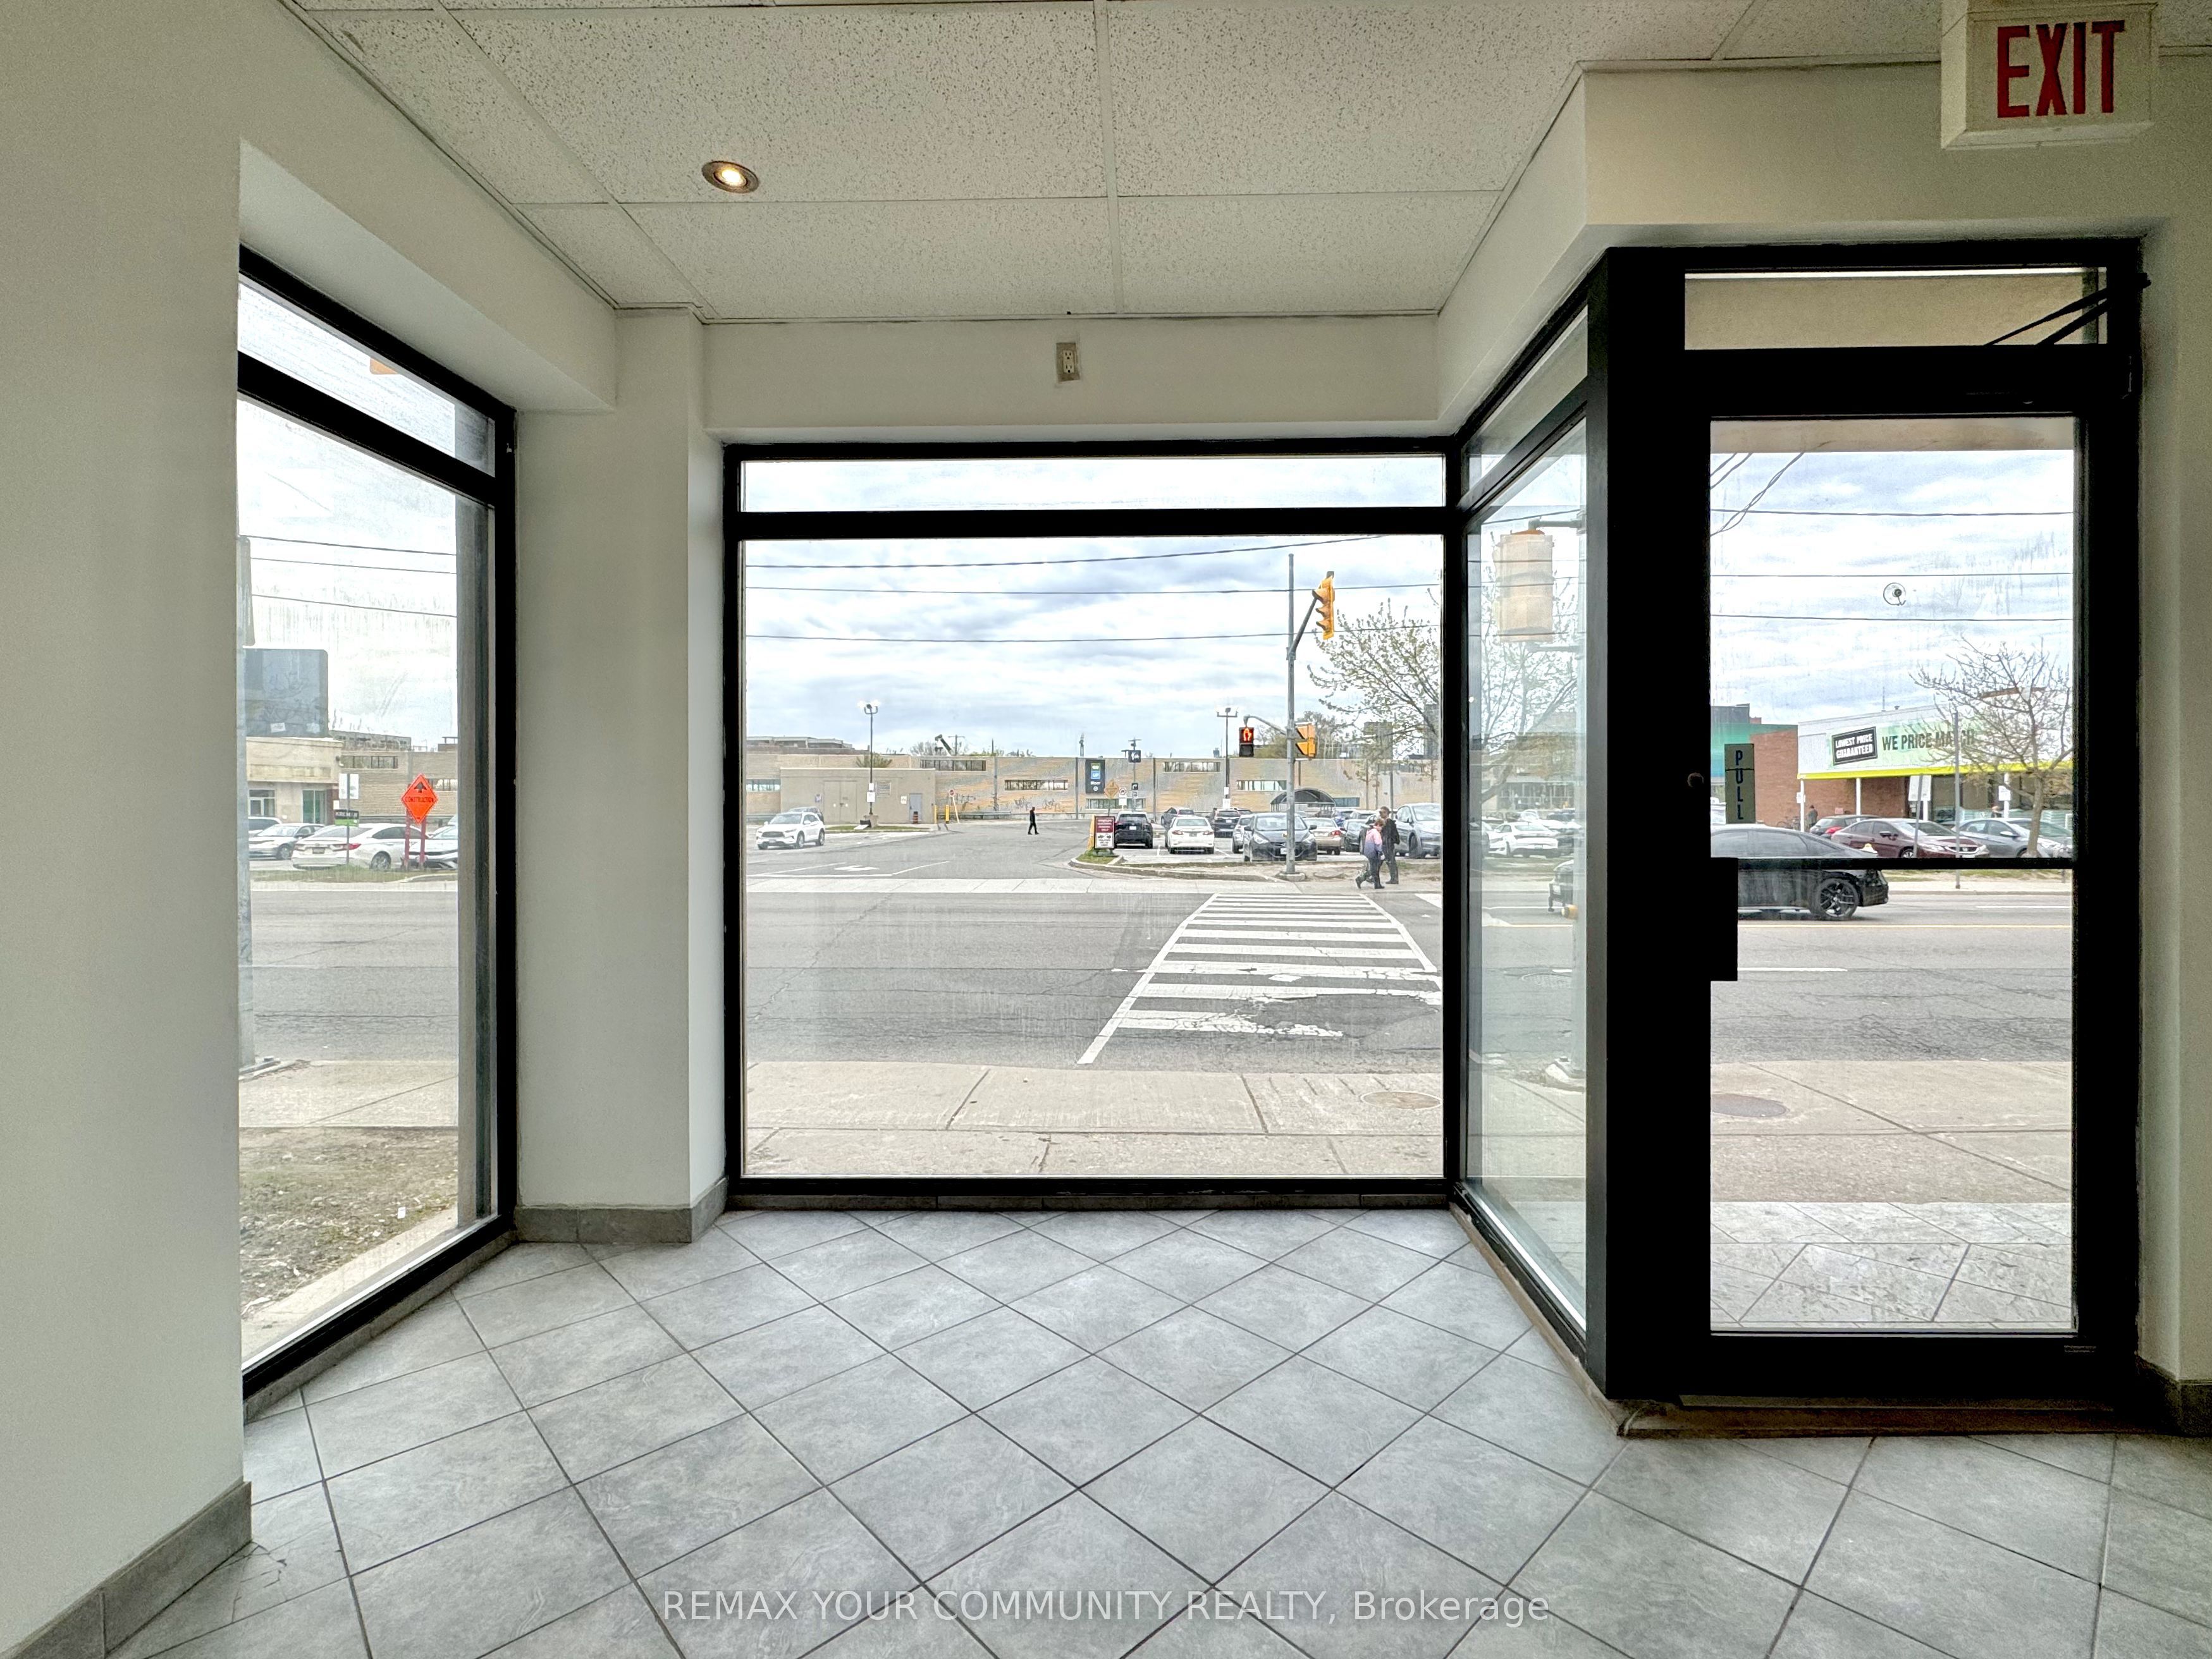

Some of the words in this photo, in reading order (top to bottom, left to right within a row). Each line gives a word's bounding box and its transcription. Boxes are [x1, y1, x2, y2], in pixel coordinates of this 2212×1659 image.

[1997, 20, 2125, 118] EXIT
[1835, 737, 1855, 748] LOWEST
[1856, 733, 1873, 744] PRICE
[1882, 735, 1899, 751] WE
[1901, 732, 1932, 750] PRICE
[1936, 729, 1974, 747] MACH
[1836, 744, 1873, 759] GUARANTEED
[1735, 749, 1744, 820] PULL
